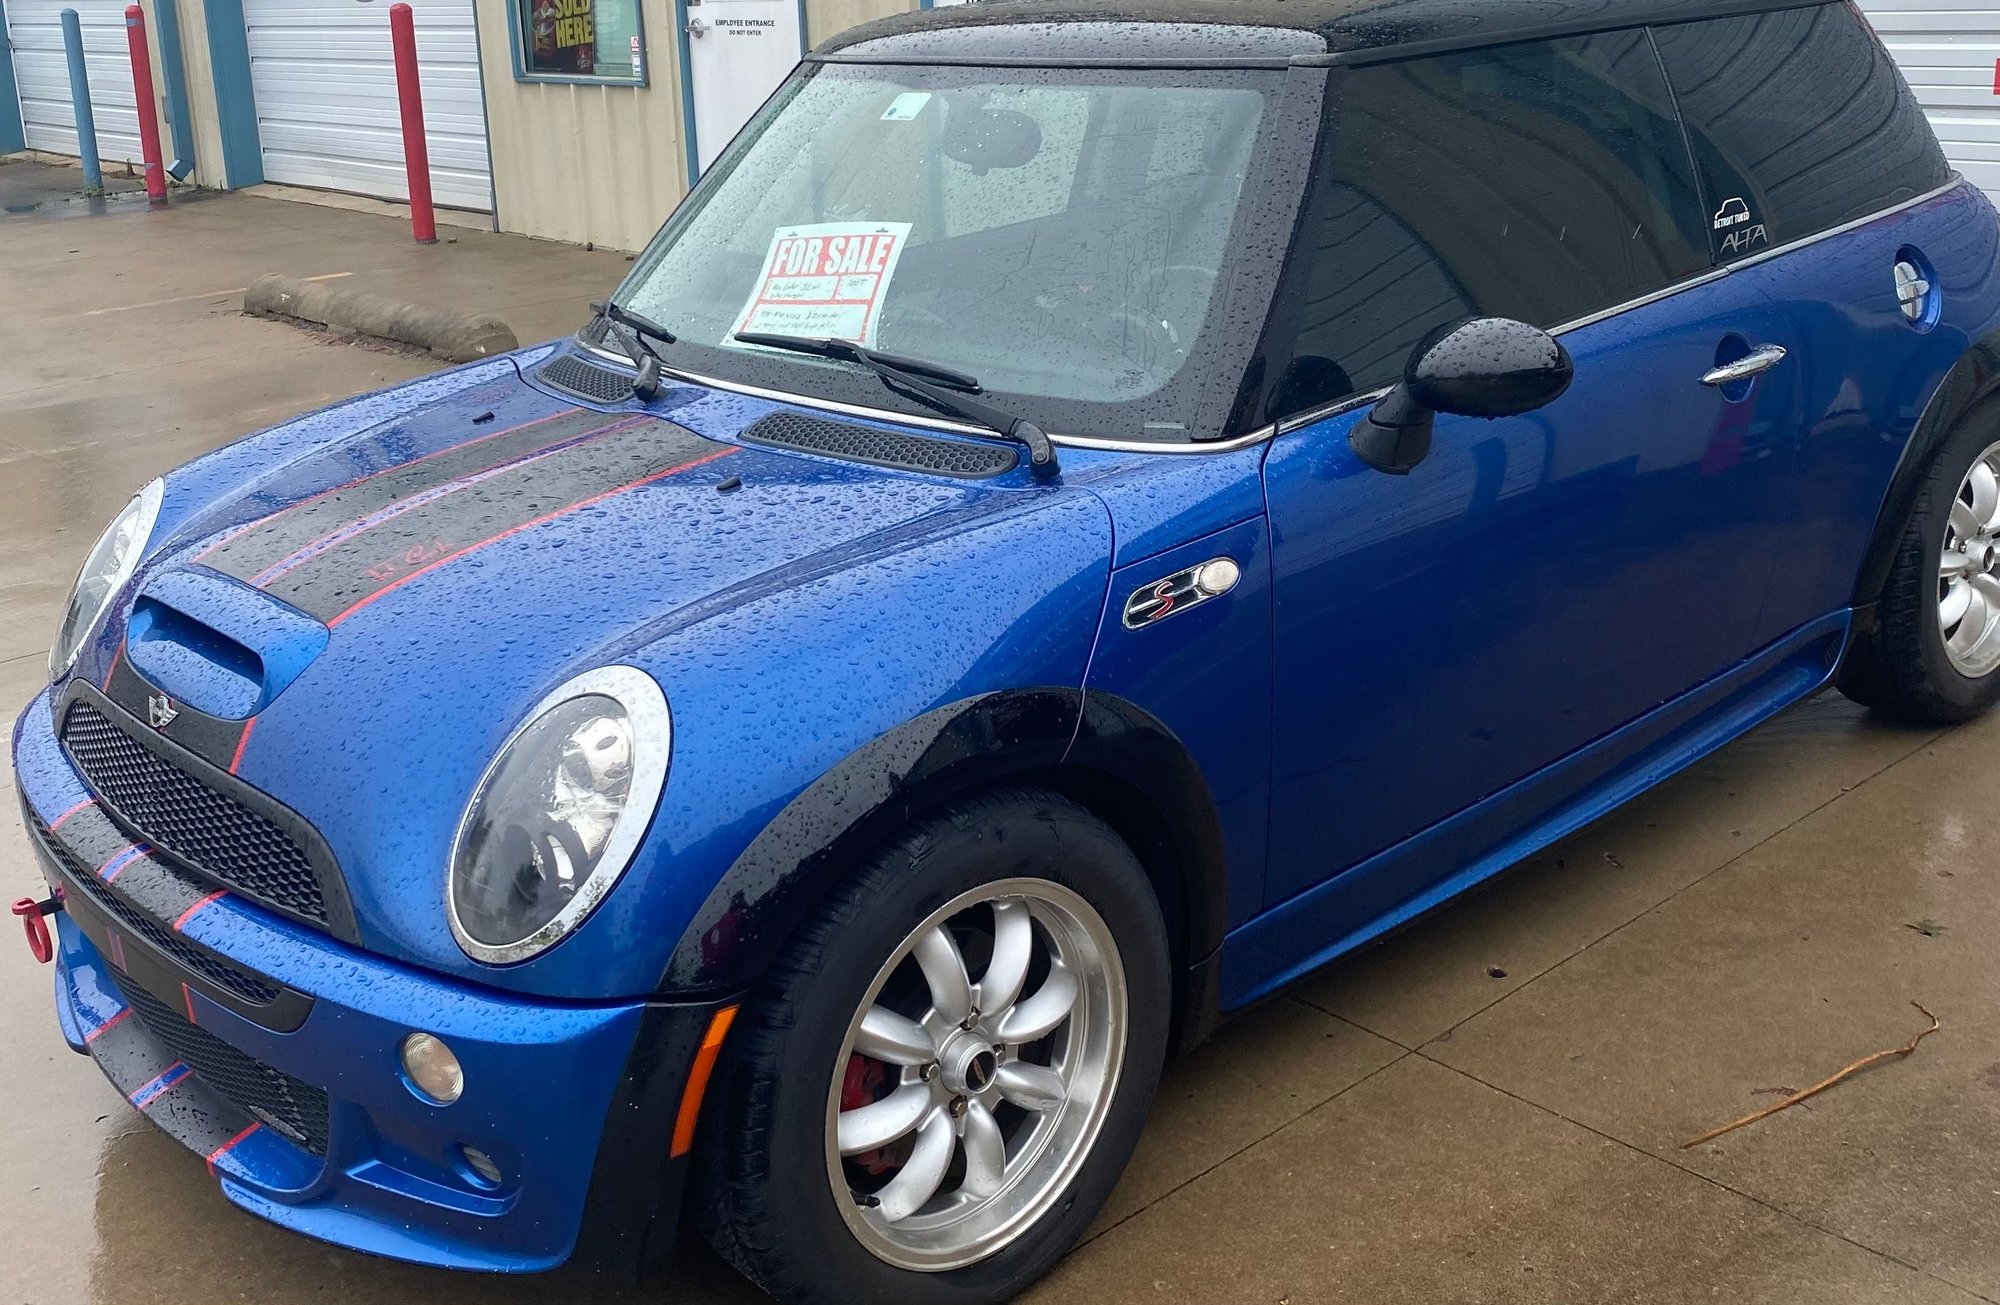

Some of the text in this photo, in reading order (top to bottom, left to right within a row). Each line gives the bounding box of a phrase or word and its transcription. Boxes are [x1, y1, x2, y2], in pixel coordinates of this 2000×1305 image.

[555, 14, 594, 48] HERE
[715, 19, 775, 27] EMPLOYEE ENTRANCE
[1713, 210, 1750, 230] DETROIT TUNED
[1720, 223, 1768, 254] ALTA
[772, 235, 894, 276] FOR SALE
[1147, 580, 1174, 620] S
